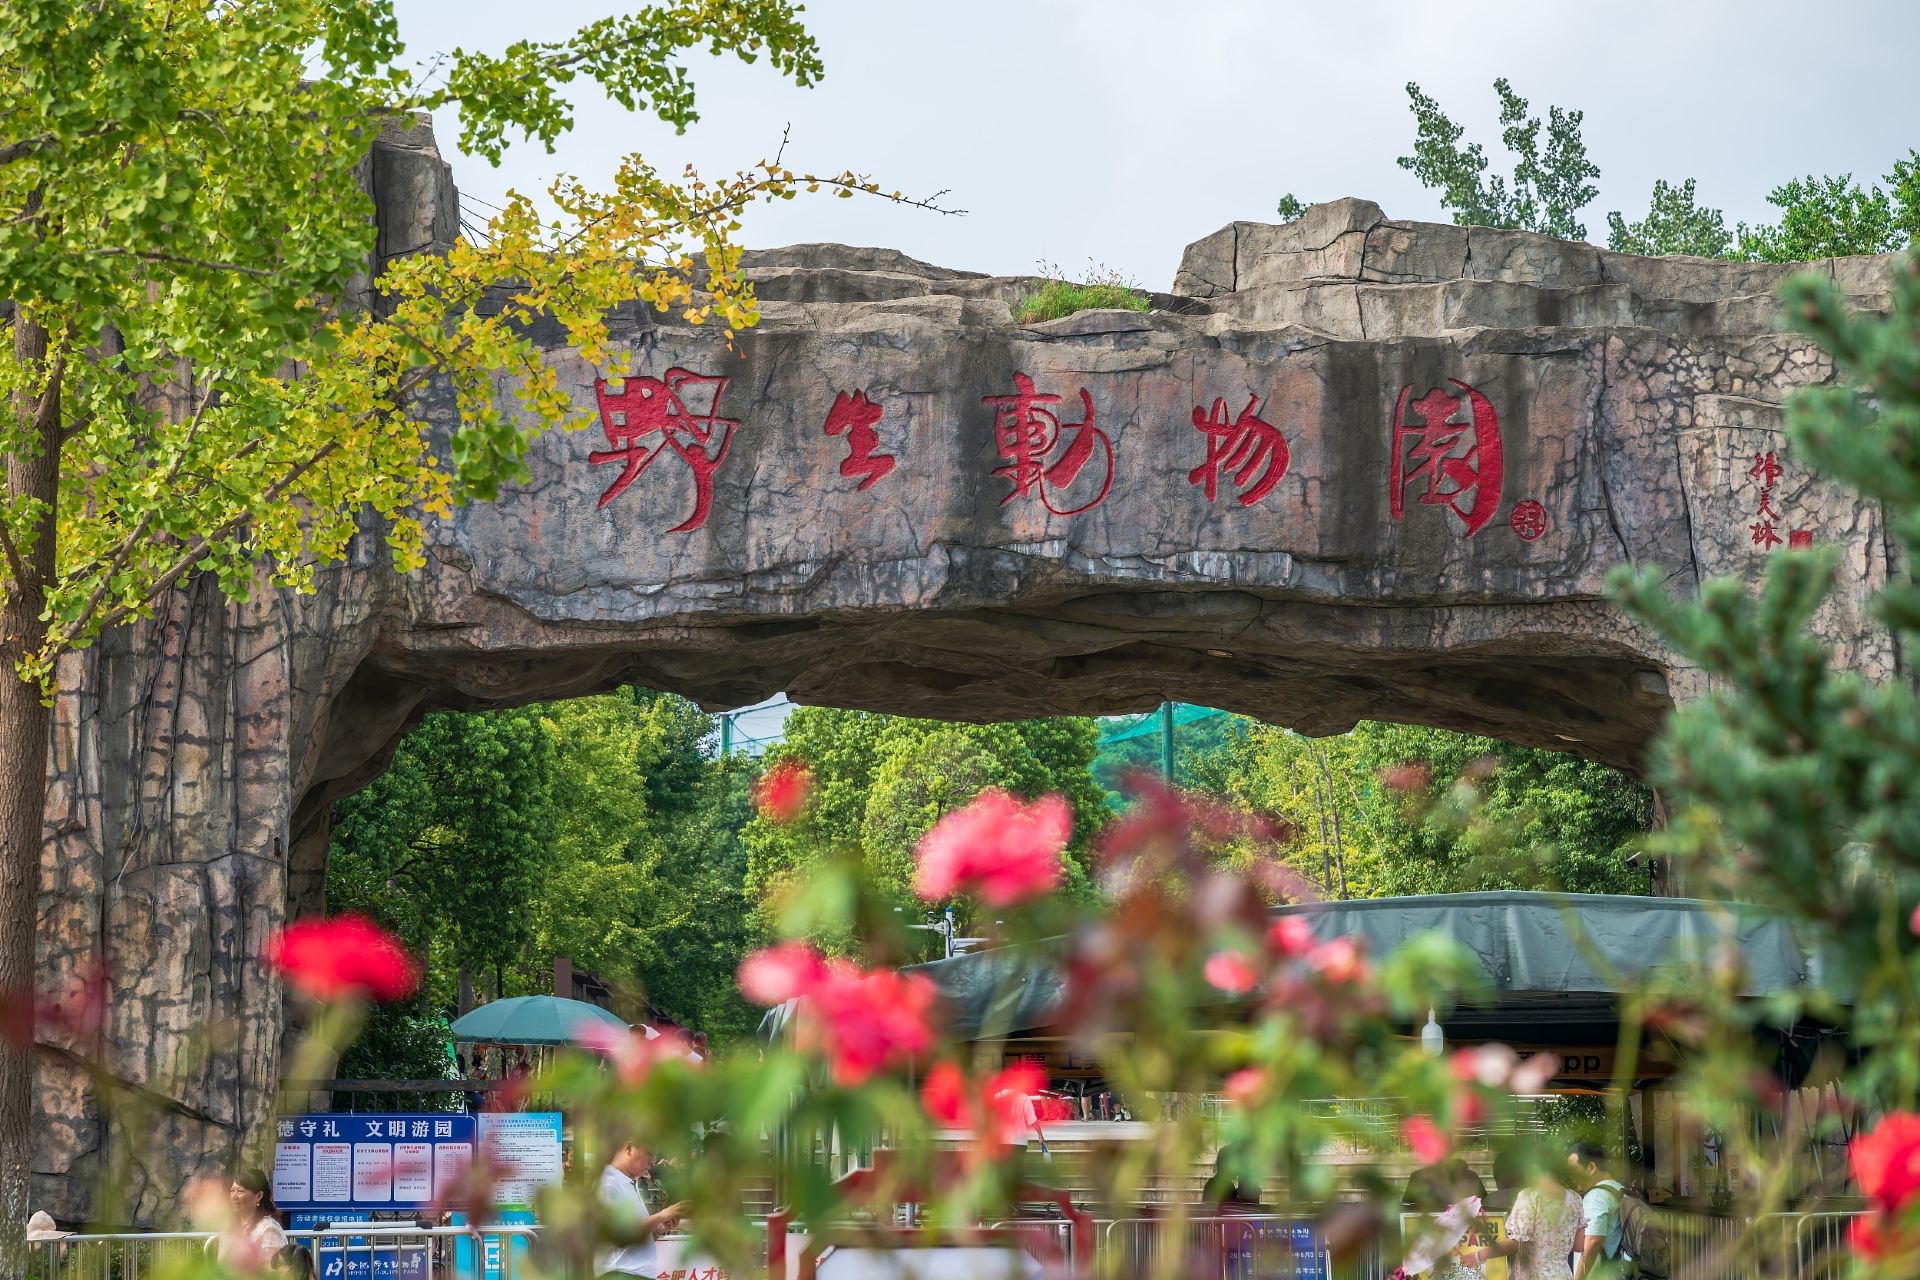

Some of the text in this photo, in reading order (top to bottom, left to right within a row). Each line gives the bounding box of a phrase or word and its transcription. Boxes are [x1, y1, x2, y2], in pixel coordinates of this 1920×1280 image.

[276, 1120, 453, 1138] 德守礼 文明游园
